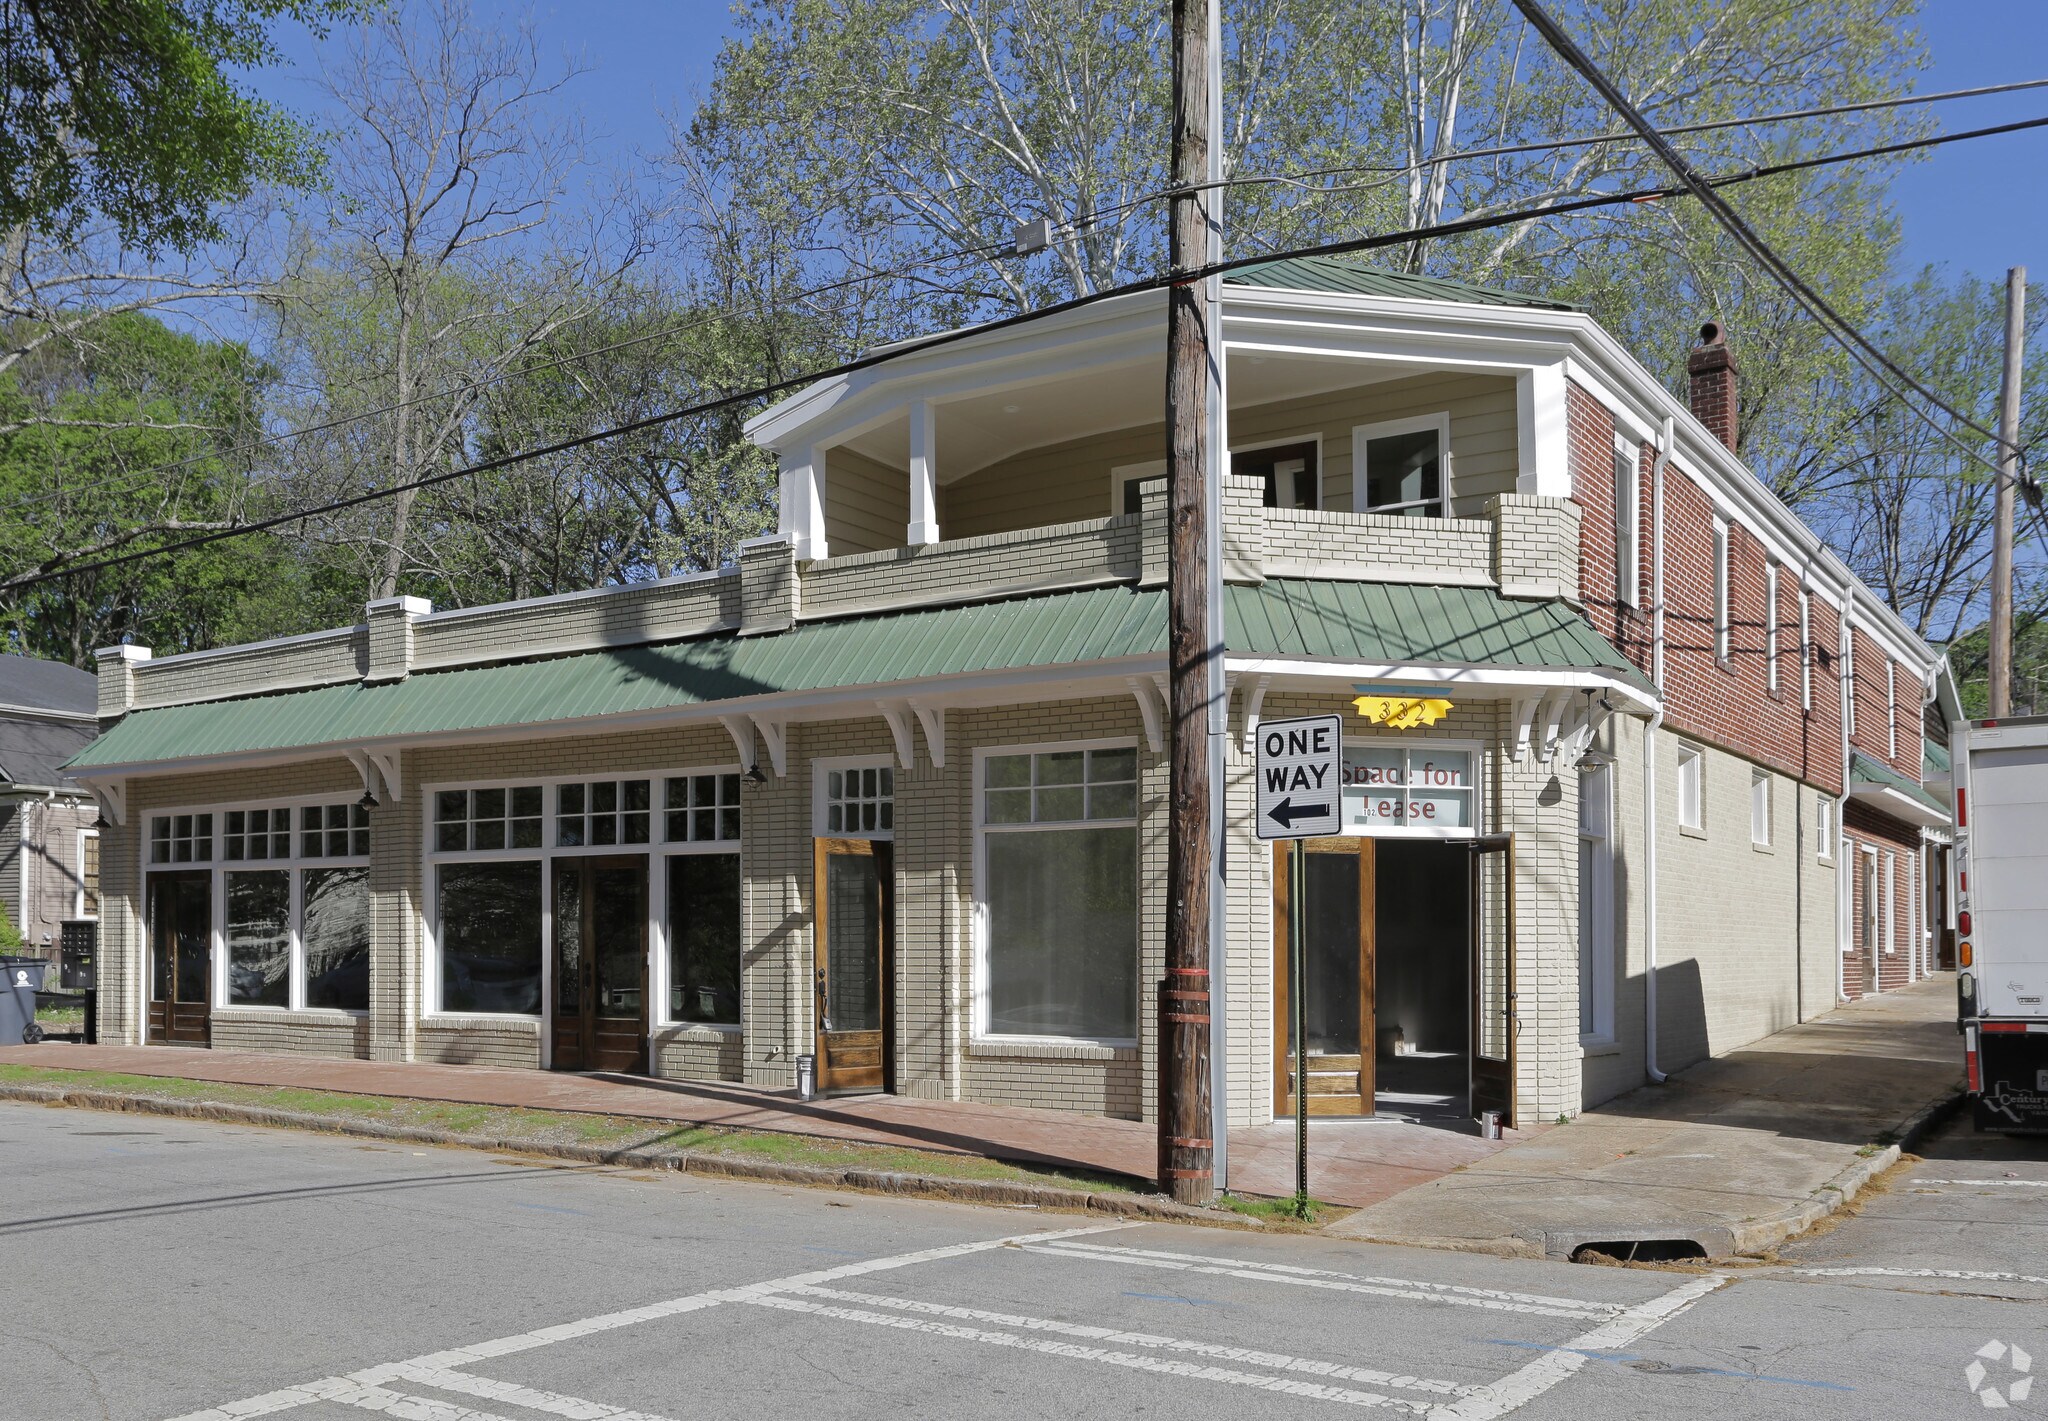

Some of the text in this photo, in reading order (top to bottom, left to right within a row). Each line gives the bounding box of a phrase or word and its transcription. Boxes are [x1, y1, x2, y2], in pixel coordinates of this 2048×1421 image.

[1379, 701, 1426, 721] 332
[1265, 727, 1331, 757] ONE
[1265, 763, 1331, 793] WAY
[1342, 760, 1461, 786] Space for
